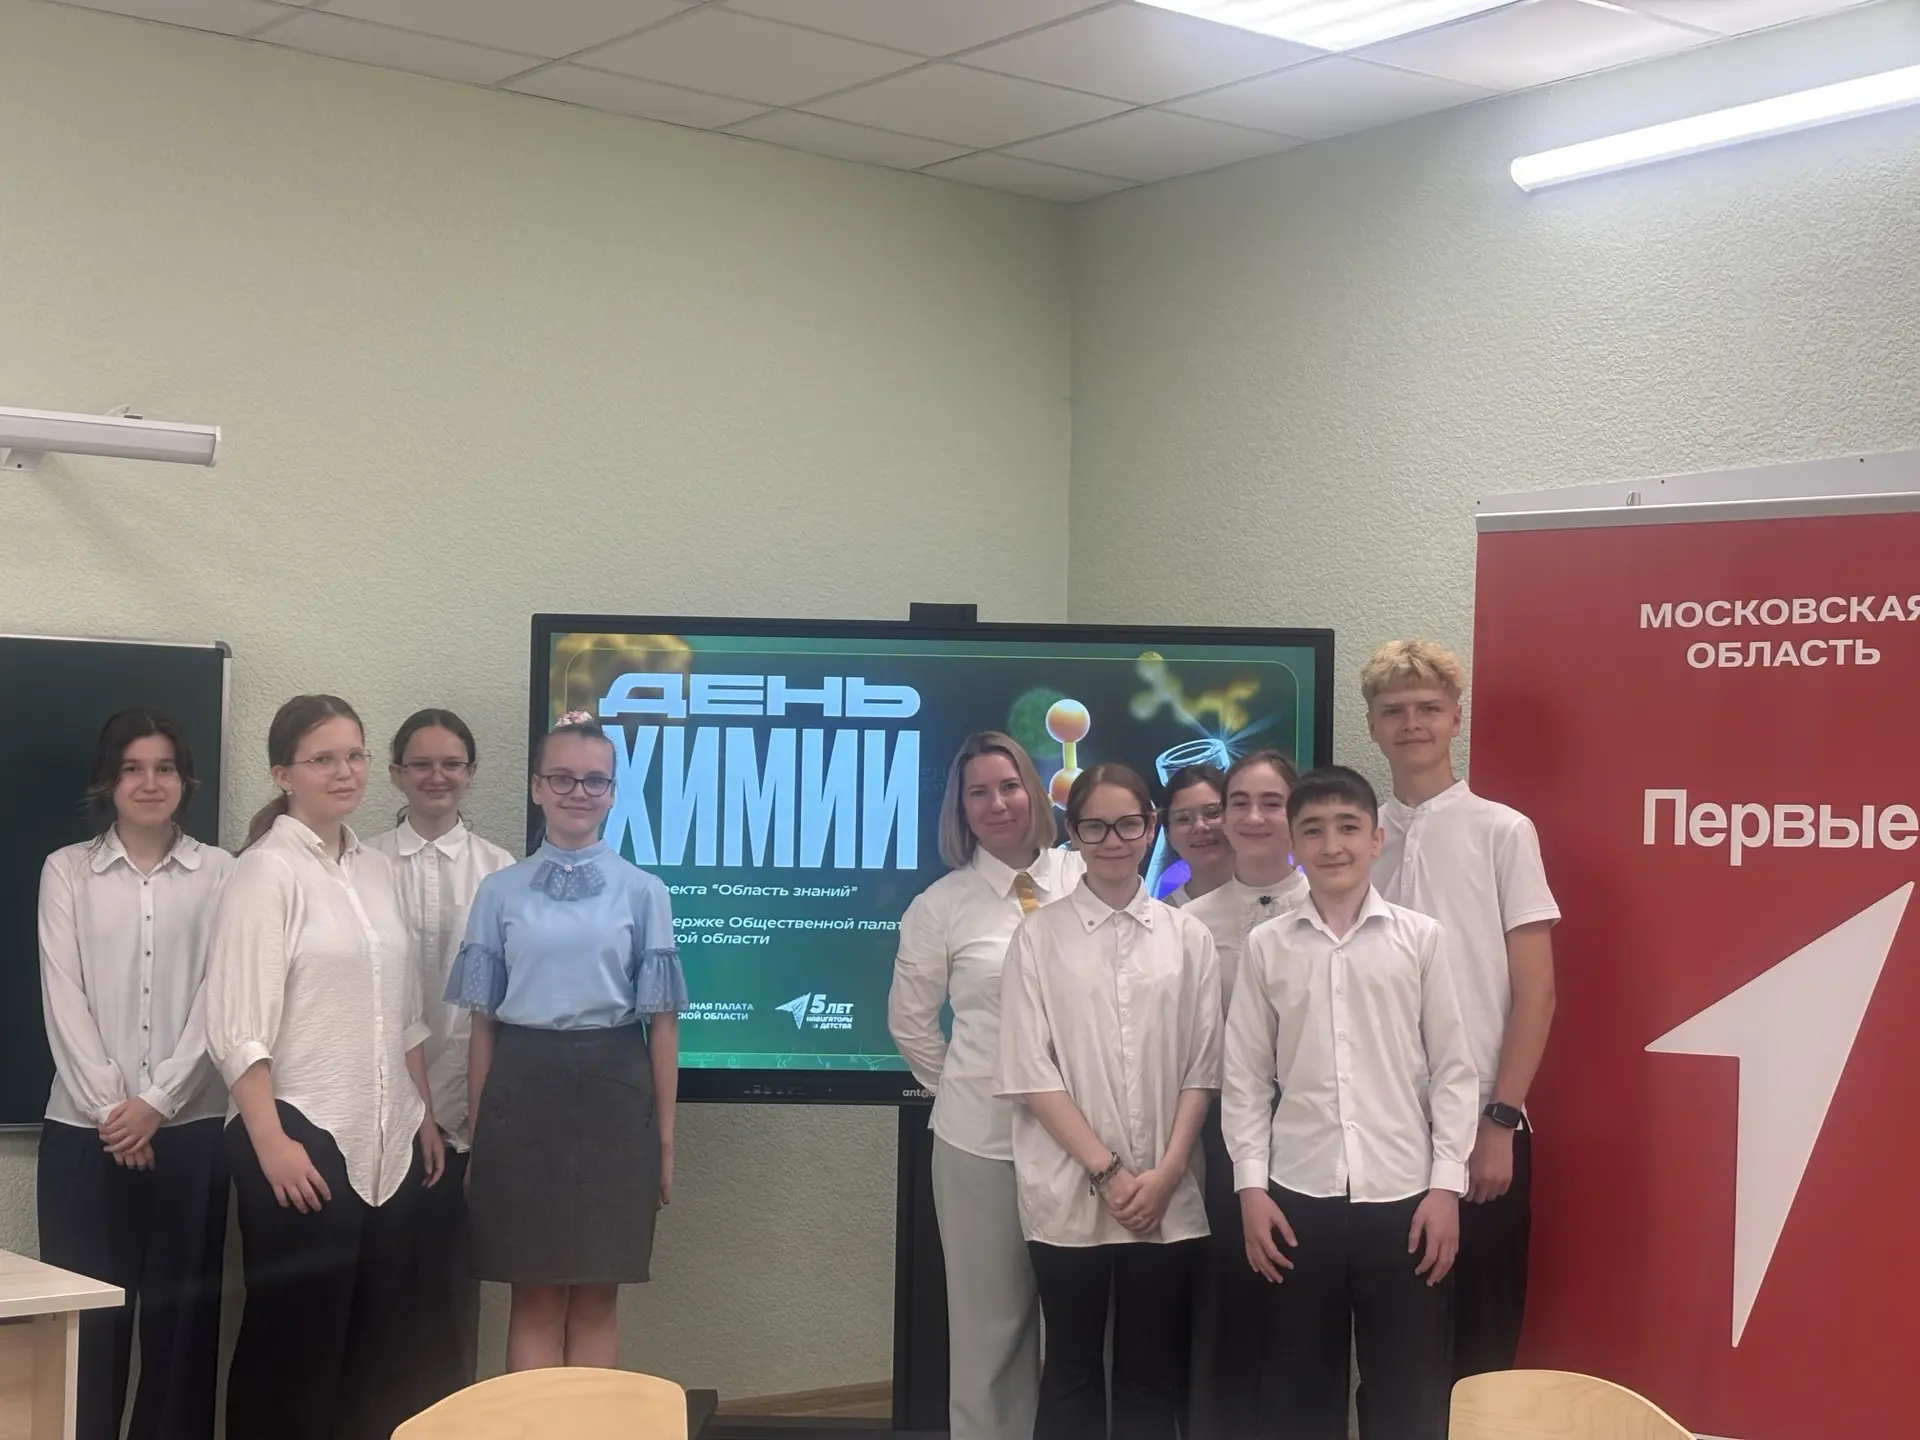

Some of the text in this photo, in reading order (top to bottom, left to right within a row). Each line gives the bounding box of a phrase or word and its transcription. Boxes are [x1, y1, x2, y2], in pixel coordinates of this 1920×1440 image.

[1640, 594, 1920, 628] МОСКОВСКАЯ
[1687, 639, 1881, 668] ОБЛАСТЬ
[599, 673, 921, 719] ДЕНЬ
[602, 725, 920, 870] ХИМИИ
[1643, 788, 1919, 866] Первые
[729, 916, 854, 930] Общественной
[702, 933, 770, 944] области
[703, 1012, 749, 1020] ОБЛАСТИ
[715, 1003, 754, 1011] ПАЛАТА
[810, 994, 854, 1014] 5 ЛЕТ
